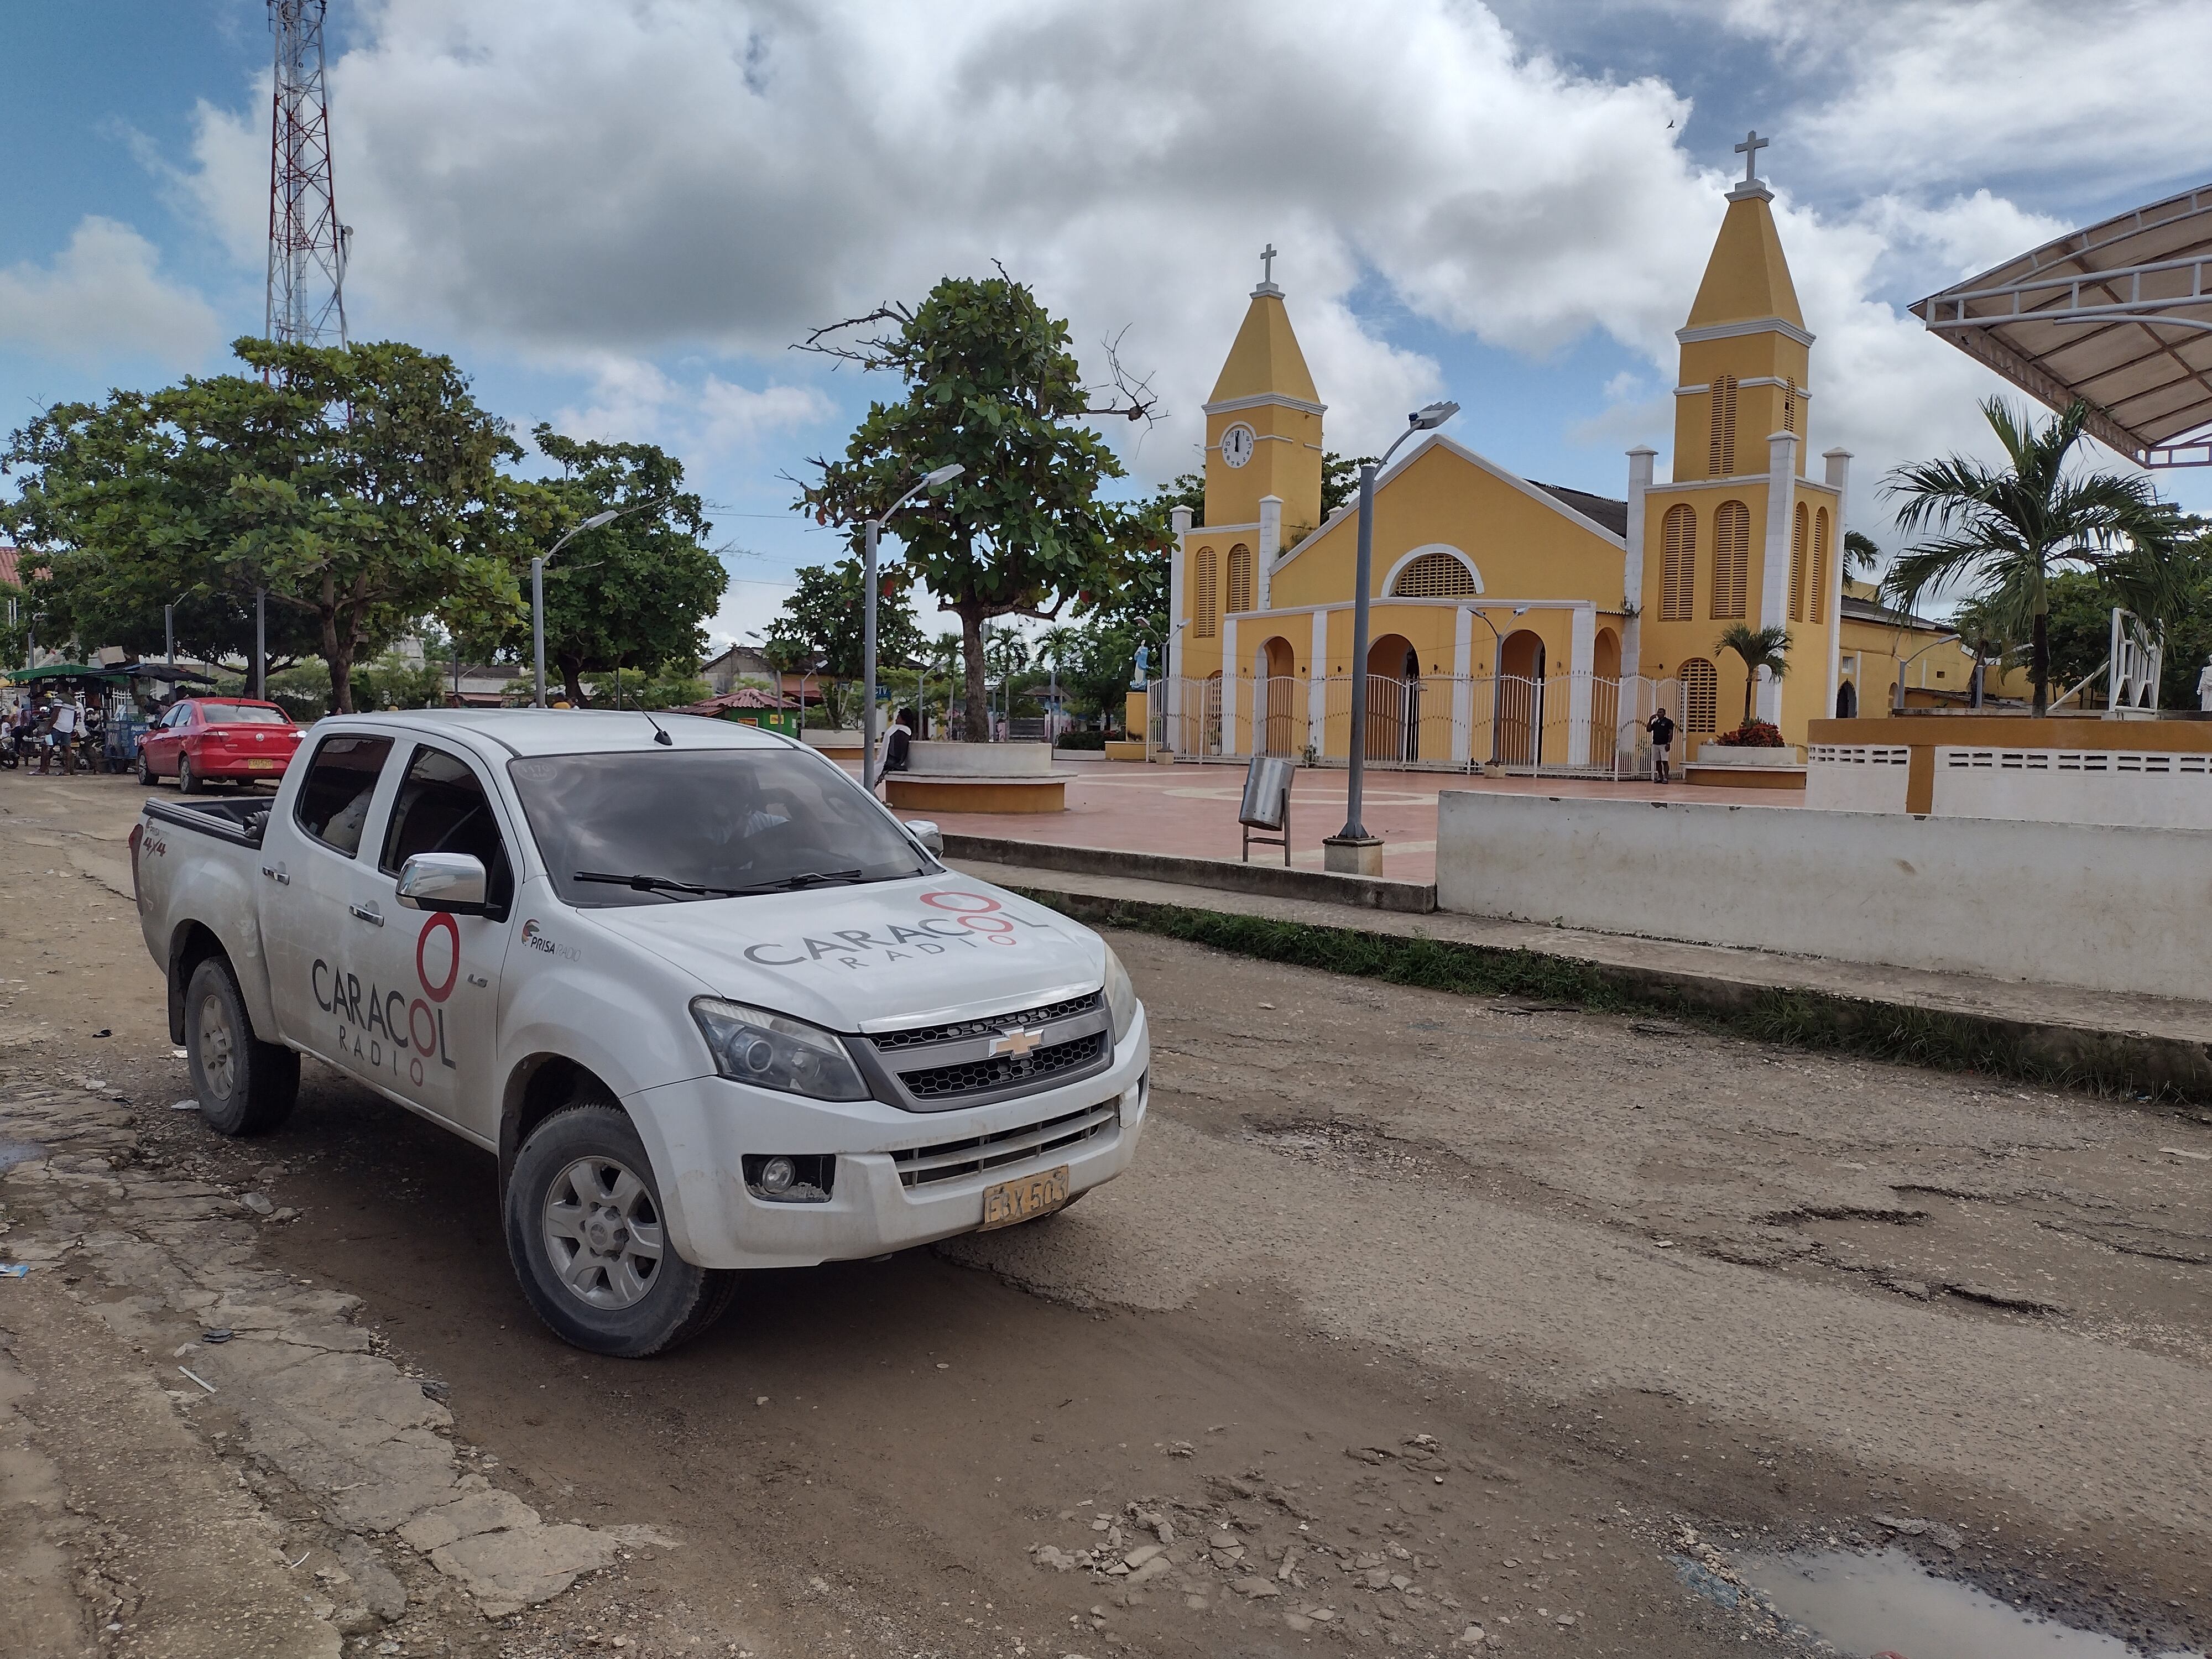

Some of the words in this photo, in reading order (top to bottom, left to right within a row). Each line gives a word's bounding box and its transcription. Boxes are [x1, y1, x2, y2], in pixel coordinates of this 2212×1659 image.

[531, 936, 555, 954] PRISA
[556, 943, 581, 962] RADIO
[743, 911, 1050, 966] CARACOL
[838, 935, 1016, 969] RADIO
[312, 958, 456, 1070] CARACOL
[339, 1024, 424, 1087] RADIO
